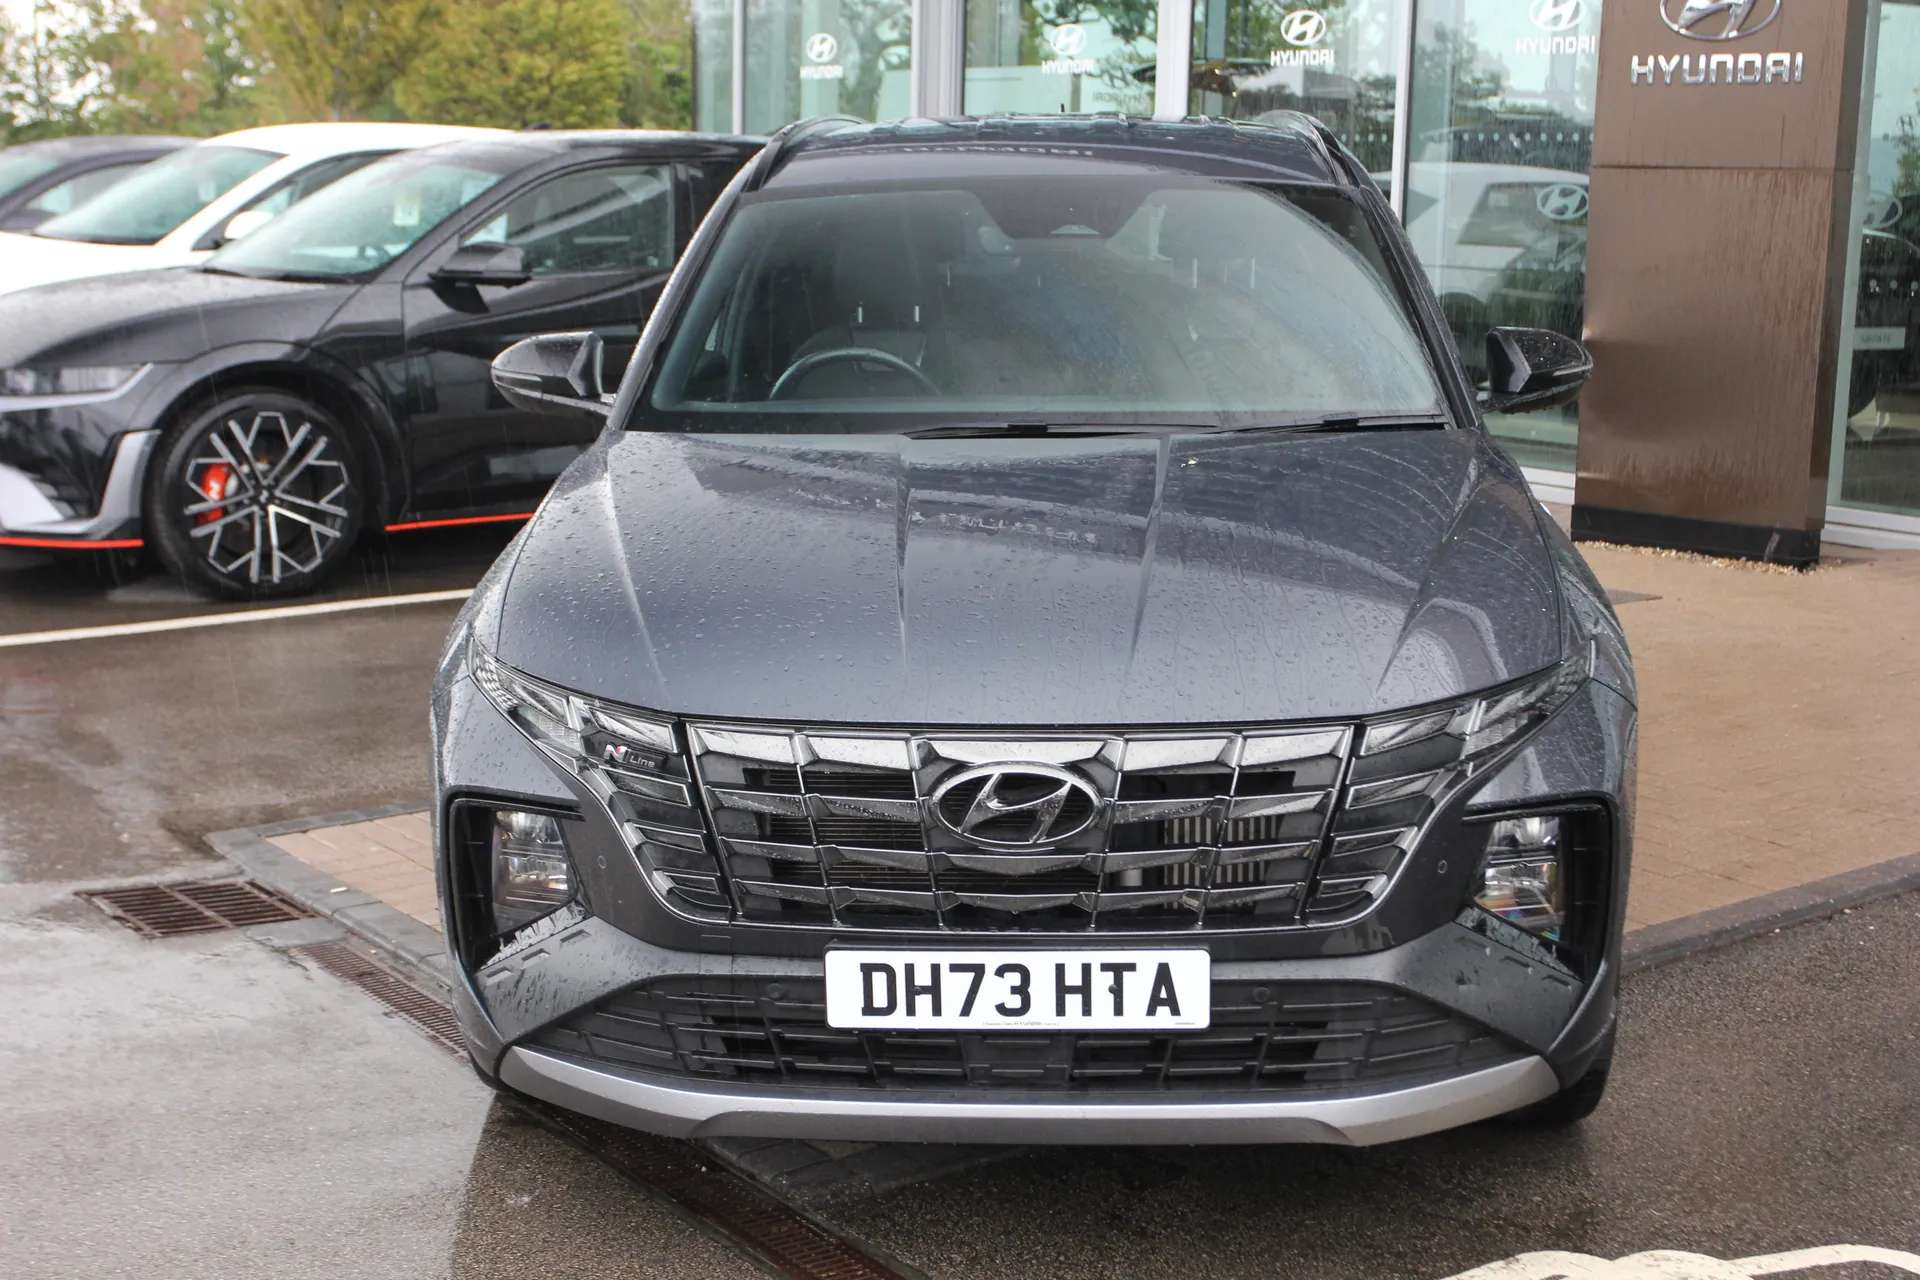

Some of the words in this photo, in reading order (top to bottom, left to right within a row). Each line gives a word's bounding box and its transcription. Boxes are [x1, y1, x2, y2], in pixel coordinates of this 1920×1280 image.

[1515, 35, 1596, 55] HYUNDAI
[1270, 48, 1335, 67] HYUNDAI
[1631, 52, 1804, 84] HYUNDAI
[603, 744, 628, 763] N
[630, 755, 656, 768] Line
[859, 962, 1031, 1017] DH73
[1054, 962, 1182, 1017] HTA
